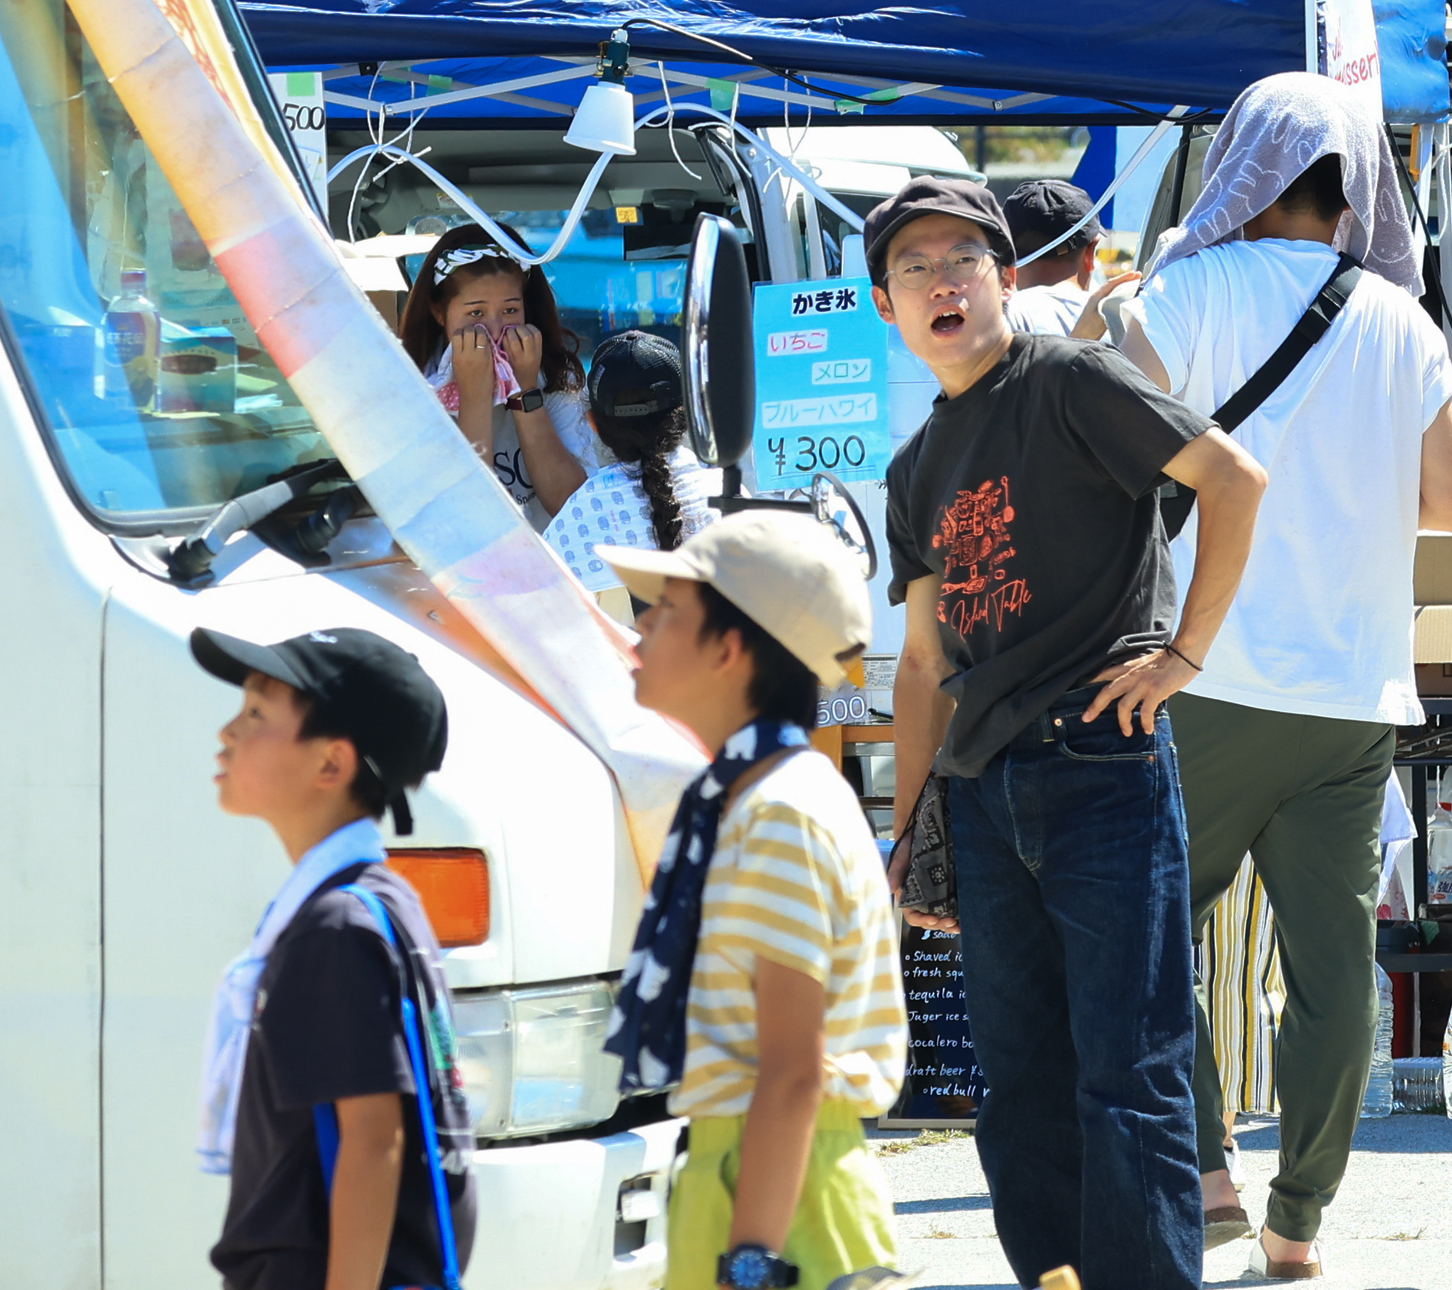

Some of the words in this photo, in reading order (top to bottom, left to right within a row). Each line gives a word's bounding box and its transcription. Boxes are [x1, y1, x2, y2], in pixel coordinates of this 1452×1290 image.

[792, 288, 856, 315] かき氷
[770, 333, 825, 352] いちご
[815, 362, 868, 381] メロン
[764, 398, 873, 423] ブルーハワイ
[817, 696, 865, 724] 500
[913, 950, 952, 962] Shaved
[913, 966, 942, 978] fresh
[909, 987, 953, 1003] tequila
[946, 1013, 960, 1021] ice
[908, 1034, 958, 1048] cocalero
[905, 1063, 936, 1077] draft
[939, 1063, 966, 1077] beer
[930, 1083, 952, 1096] red
[953, 1083, 976, 1097] bull
